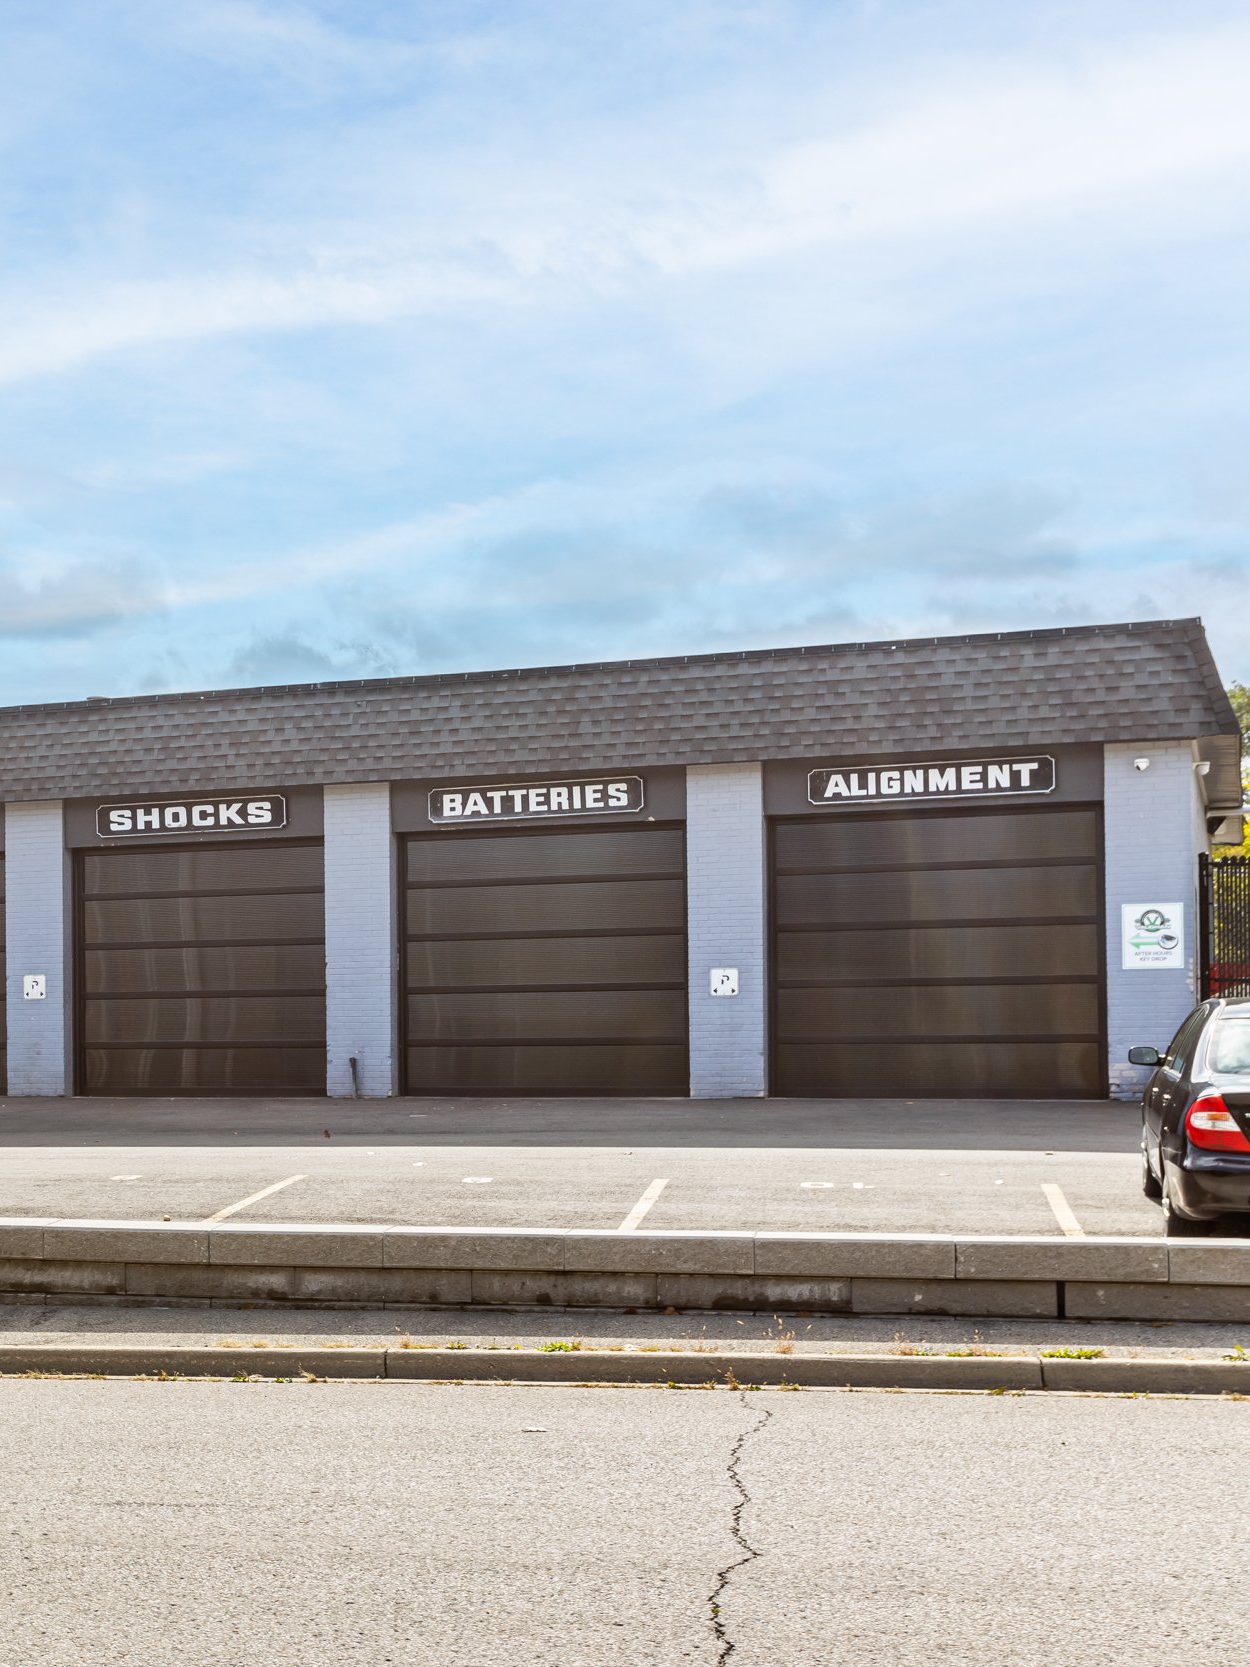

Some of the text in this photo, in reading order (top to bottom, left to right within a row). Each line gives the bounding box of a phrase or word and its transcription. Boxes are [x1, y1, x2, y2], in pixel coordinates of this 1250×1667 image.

[823, 762, 1039, 797] ALIGNMENT
[109, 801, 273, 831] SHOCKS
[442, 782, 629, 817] BATTERIES
